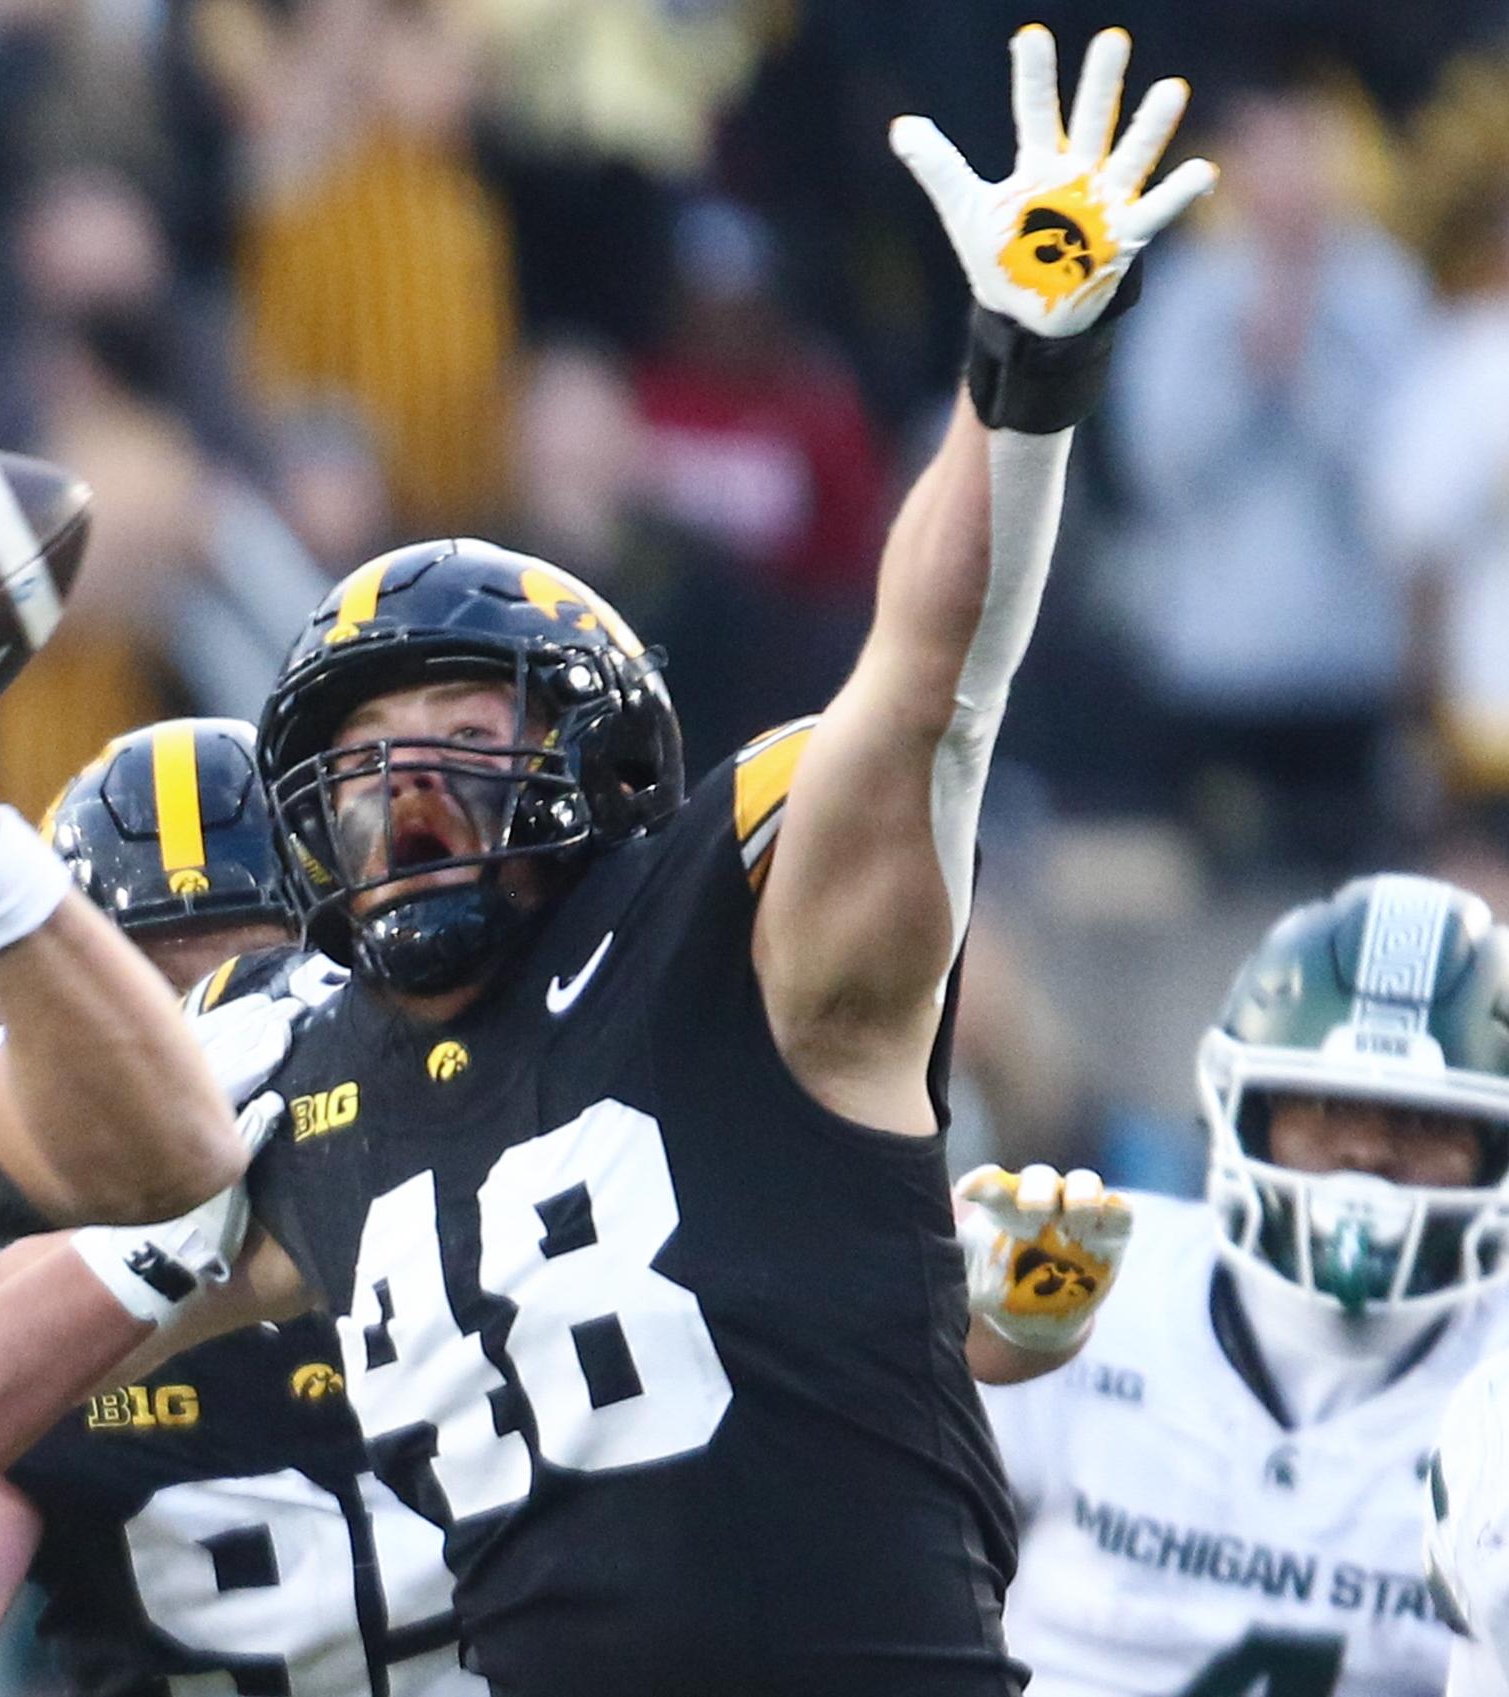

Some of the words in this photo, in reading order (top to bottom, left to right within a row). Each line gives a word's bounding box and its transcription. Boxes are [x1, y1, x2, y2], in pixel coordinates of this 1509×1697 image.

[336, 1097, 734, 1522] 48
[1073, 1492, 1319, 1606] MICHIGAN
[1329, 1562, 1432, 1622] STA
